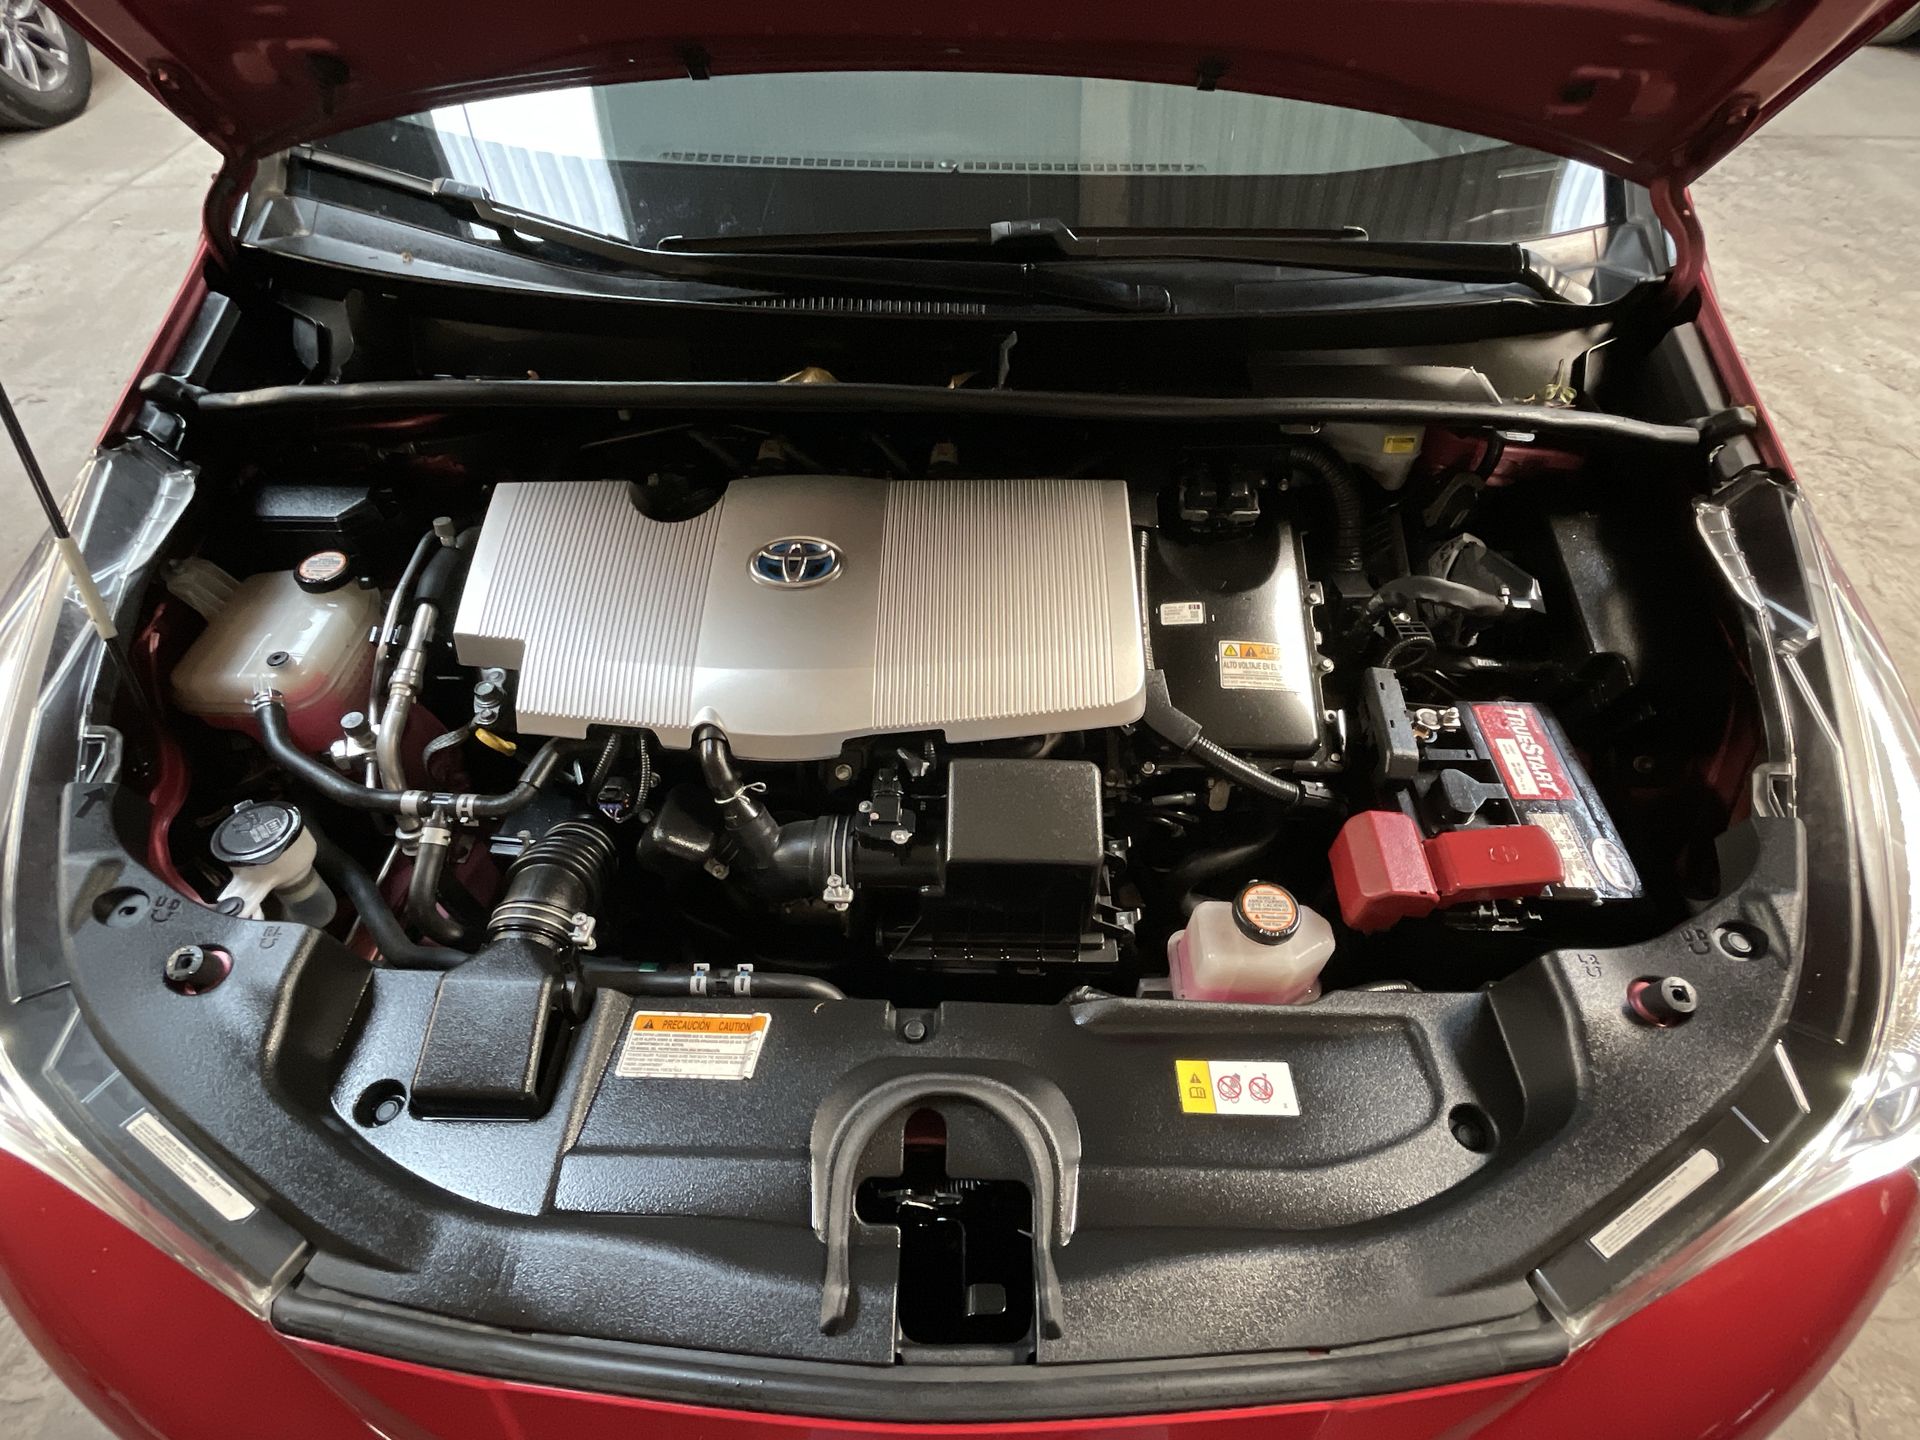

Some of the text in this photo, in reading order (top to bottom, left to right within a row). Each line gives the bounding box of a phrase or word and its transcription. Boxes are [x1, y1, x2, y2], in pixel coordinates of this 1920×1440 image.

[1223, 661, 1237, 669] ALTO
[1238, 661, 1262, 670] VOLTAJE
[1262, 662, 1270, 671] EN
[718, 1021, 751, 1032] CAUTION
